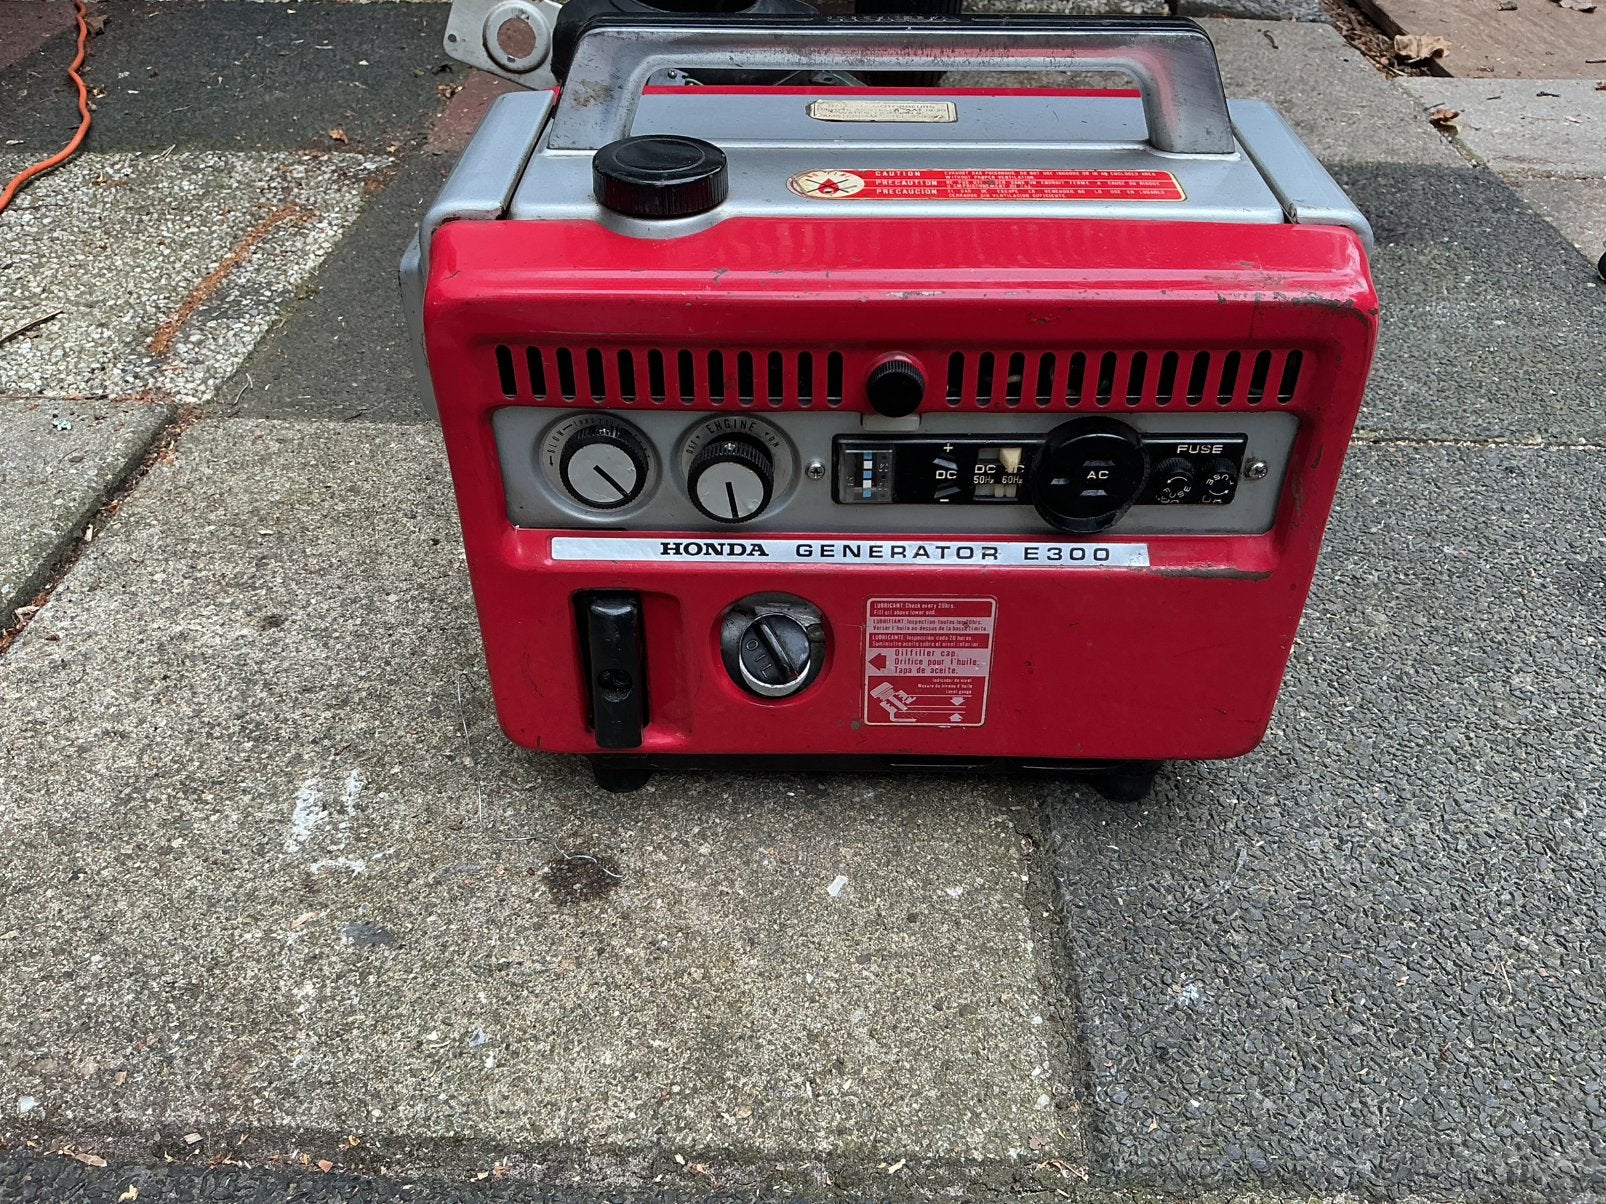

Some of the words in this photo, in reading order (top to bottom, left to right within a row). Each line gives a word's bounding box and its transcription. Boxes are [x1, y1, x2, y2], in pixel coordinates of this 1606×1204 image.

[706, 418, 757, 434] ENGINE
[547, 430, 565, 454] SLOW
[686, 440, 698, 454] OFF
[768, 436, 781, 448] ON
[1177, 445, 1224, 454] FUSE
[974, 464, 996, 473] DC
[936, 470, 958, 479] DC
[1086, 470, 1109, 479] AC
[973, 476, 994, 484] 50Hz
[1002, 476, 1024, 484] 60Hz
[1162, 485, 1192, 498] FUSE
[660, 542, 769, 556] HONDA
[796, 544, 999, 561] GENERATOR
[1024, 547, 1111, 562] E300
[746, 639, 772, 680] OIL
[894, 658, 924, 666] Orifice
[950, 658, 980, 666] l'huile.
[894, 666, 912, 674] Tapa
